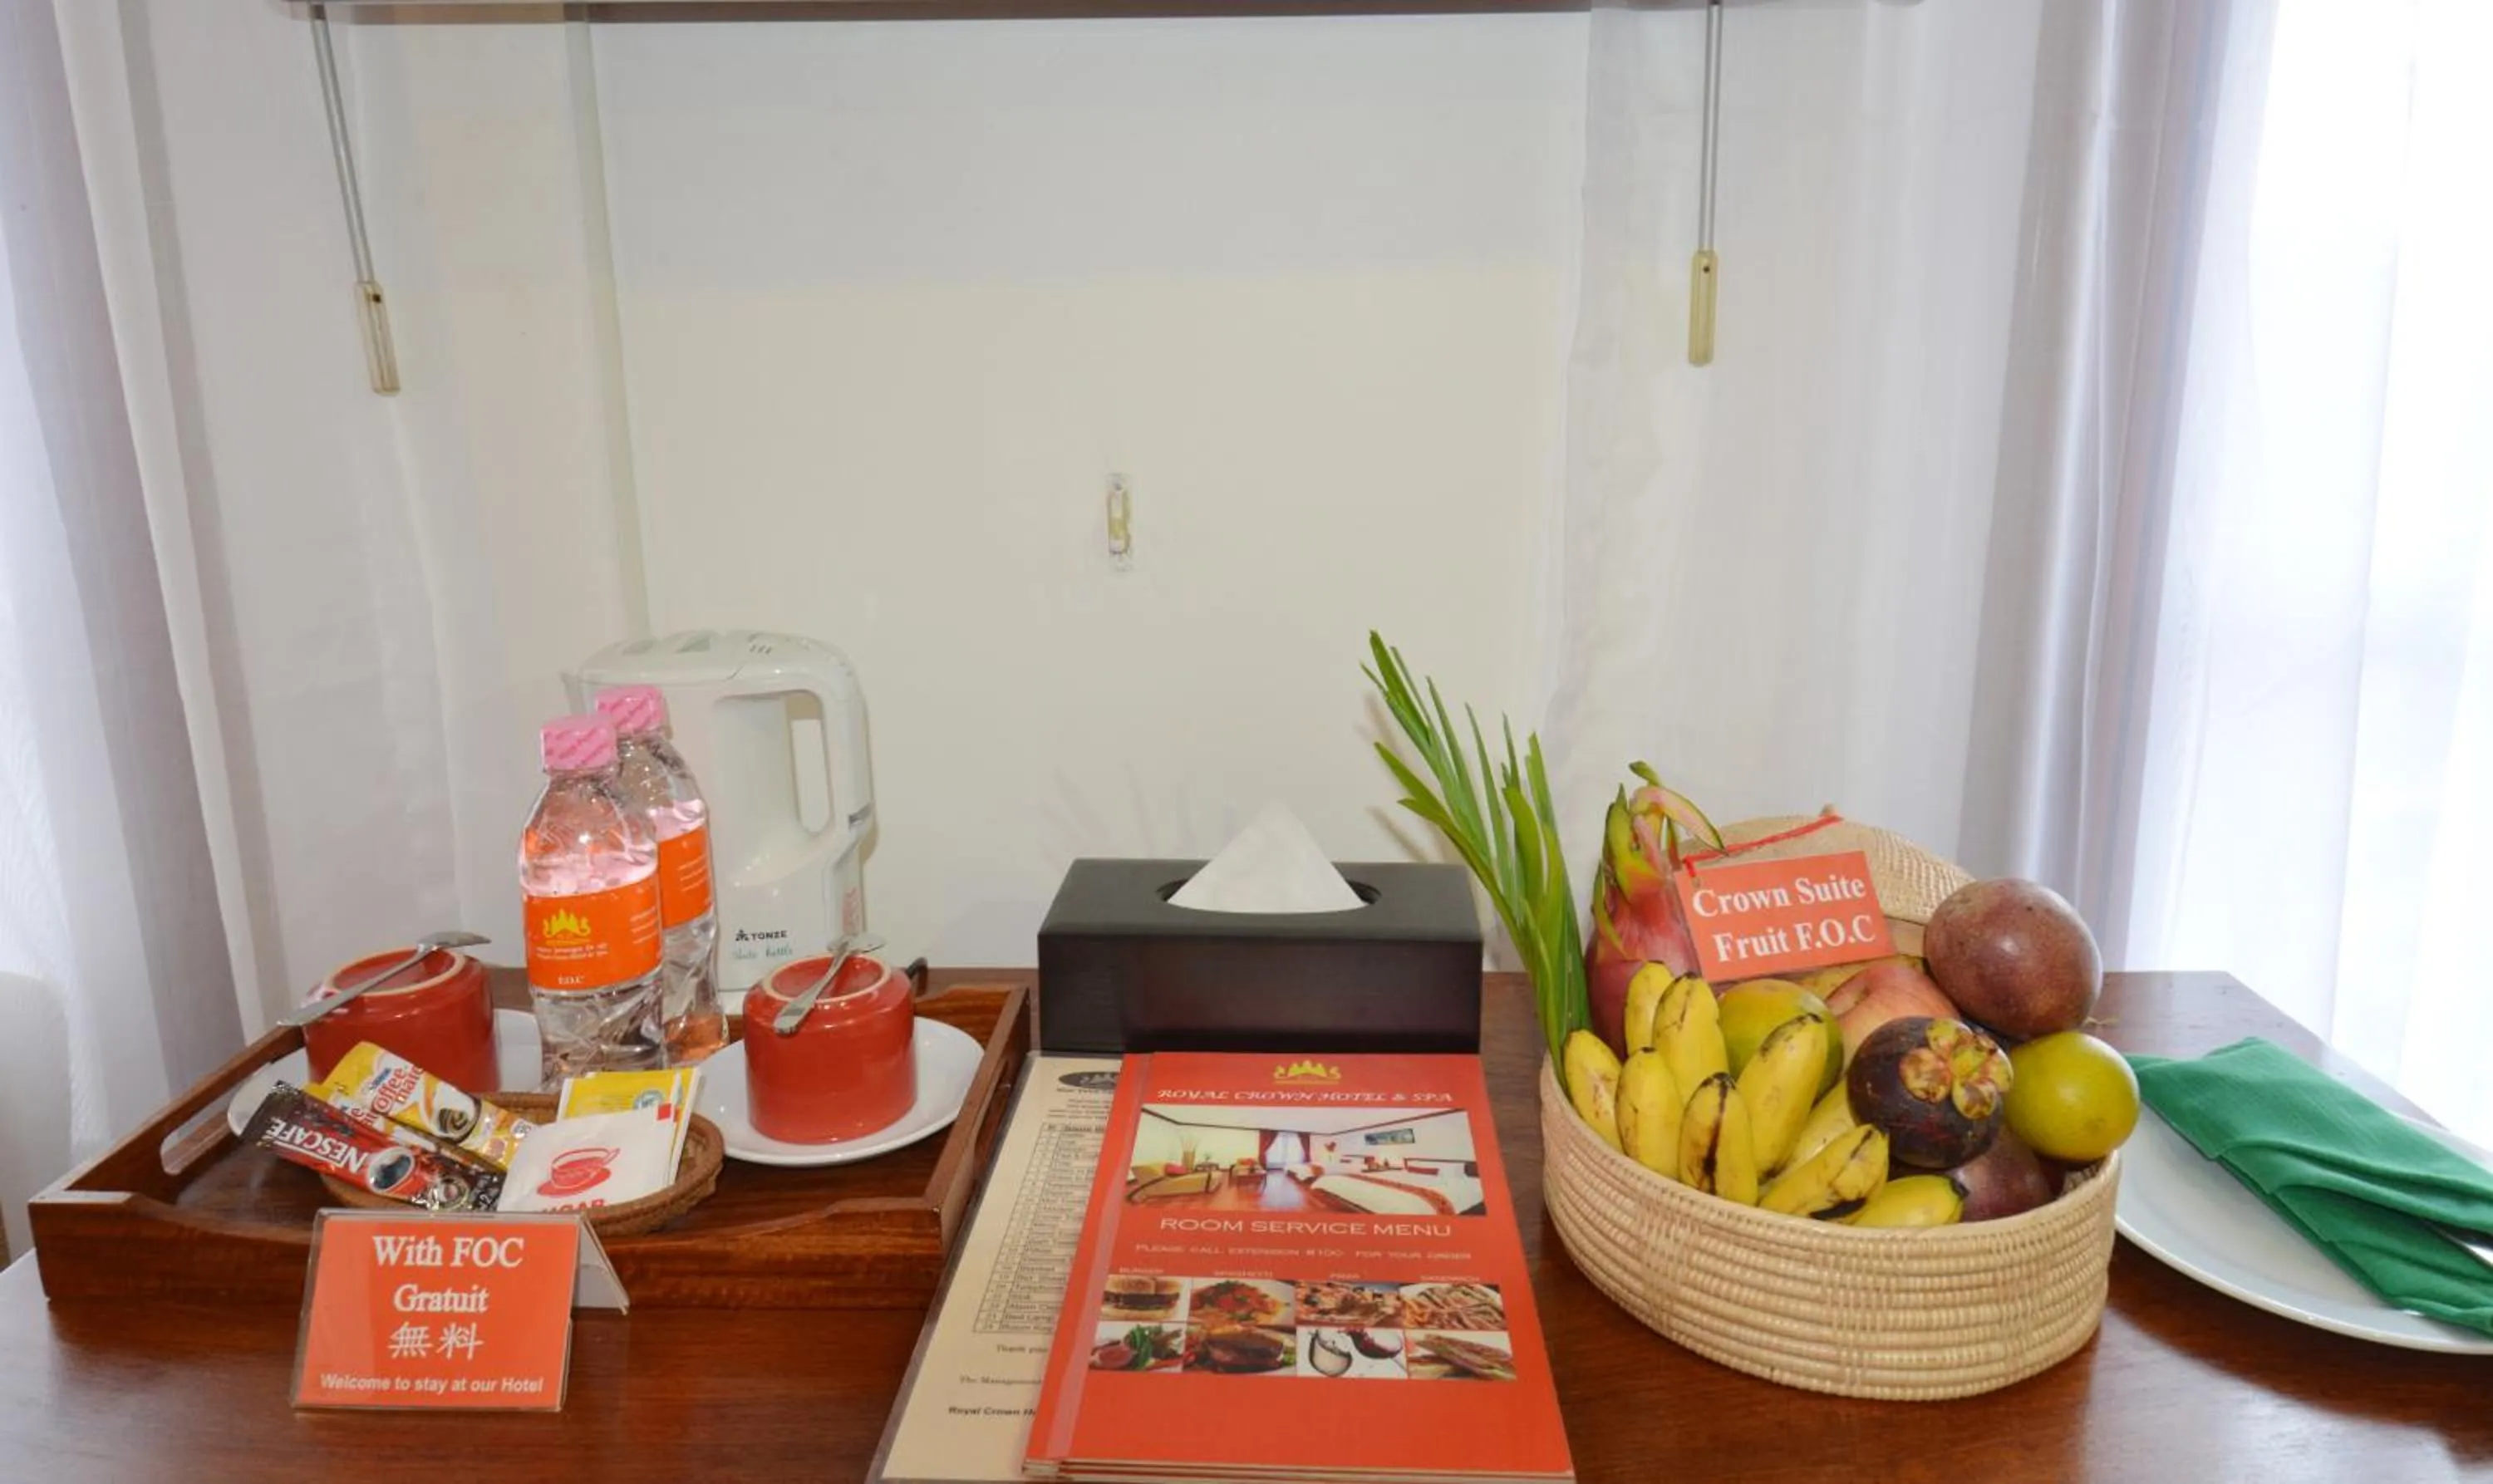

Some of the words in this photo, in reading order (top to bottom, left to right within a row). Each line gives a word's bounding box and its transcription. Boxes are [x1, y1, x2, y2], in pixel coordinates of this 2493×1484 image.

[1693, 887, 1792, 917] Crown
[1795, 875, 1866, 905] Suite
[750, 930, 787, 941] TONZE
[1712, 926, 1791, 962] Fruit
[1794, 915, 1876, 951] F.O.C
[1157, 1089, 1230, 1099] ROYAL
[1234, 1090, 1314, 1101] CROWN
[1315, 1091, 1385, 1102] HOTEL
[1392, 1092, 1407, 1102] &
[1413, 1092, 1454, 1103] SPA
[1160, 1218, 1244, 1232] ROOM
[1250, 1220, 1367, 1236] SERVICE
[1373, 1223, 1452, 1237] MENU
[372, 1235, 444, 1267] With
[450, 1236, 525, 1268] FOC
[1135, 1243, 1184, 1253] PLEASE
[1189, 1245, 1224, 1255] CALL
[1355, 1250, 1383, 1258] FOR
[1388, 1251, 1423, 1260] YOUR
[393, 1283, 490, 1314] Gratuit
[387, 1321, 484, 1361] 無料
[320, 1373, 391, 1393] Welcome
[395, 1376, 411, 1393] to
[414, 1376, 450, 1397] stay
[450, 1377, 468, 1393] at
[470, 1379, 499, 1393] our
[501, 1377, 545, 1393] Hotel
[948, 1406, 982, 1416] Royal
[983, 1407, 1021, 1415] Crown
